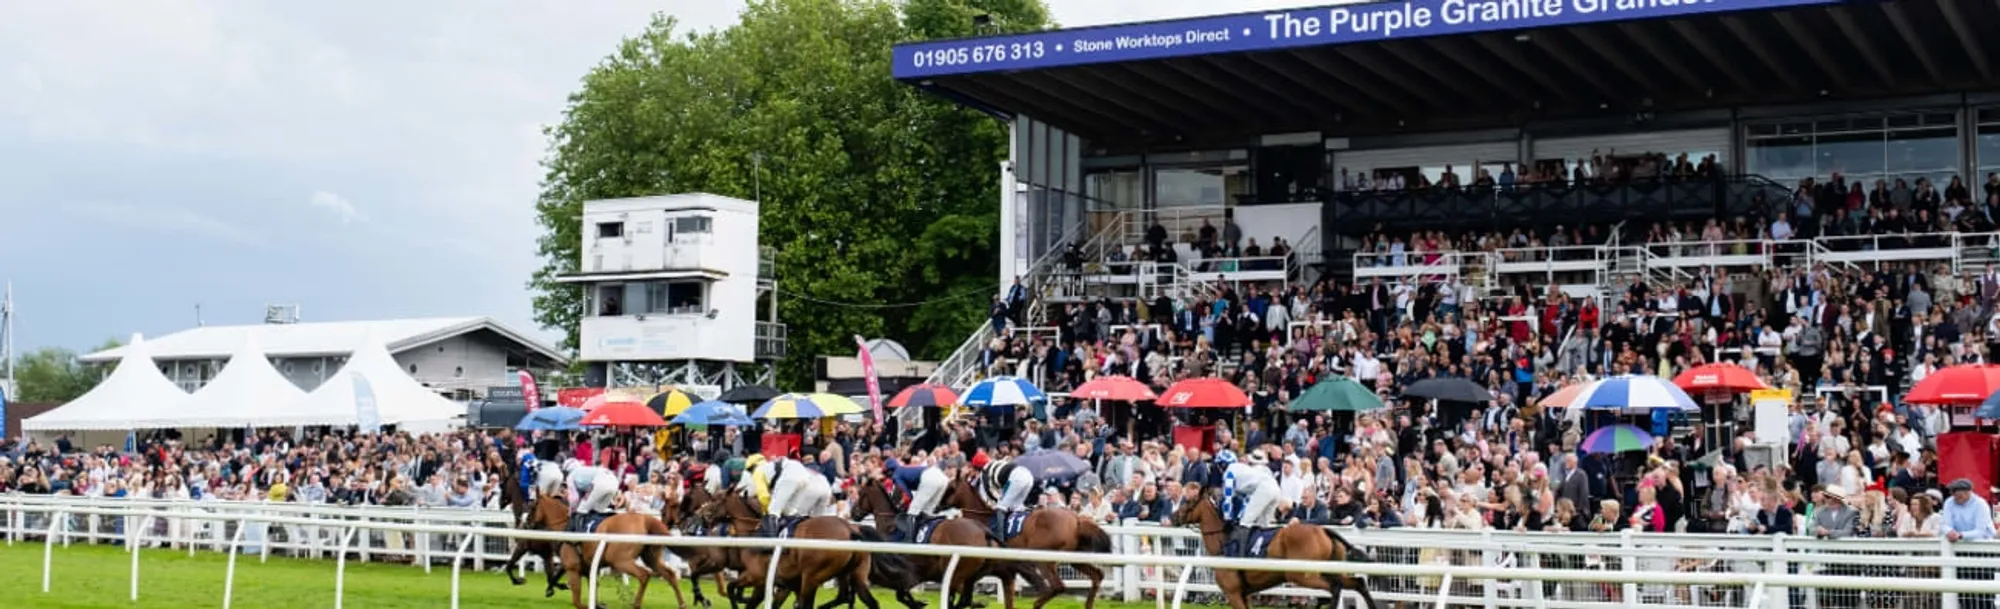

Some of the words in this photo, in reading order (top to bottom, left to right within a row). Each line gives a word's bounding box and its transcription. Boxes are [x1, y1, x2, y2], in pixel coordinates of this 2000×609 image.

[913, 47, 968, 67] 01905
[972, 44, 1006, 64] 676
[1010, 41, 1045, 61] 313
[1074, 38, 1113, 53] Stone
[1115, 33, 1182, 50] Worktops
[1186, 28, 1229, 43] Direct
[1264, 12, 1321, 39] The
[1330, 3, 1432, 36] Purple
[1440, 0, 1563, 25] Granite
[1250, 535, 1264, 555] 4
